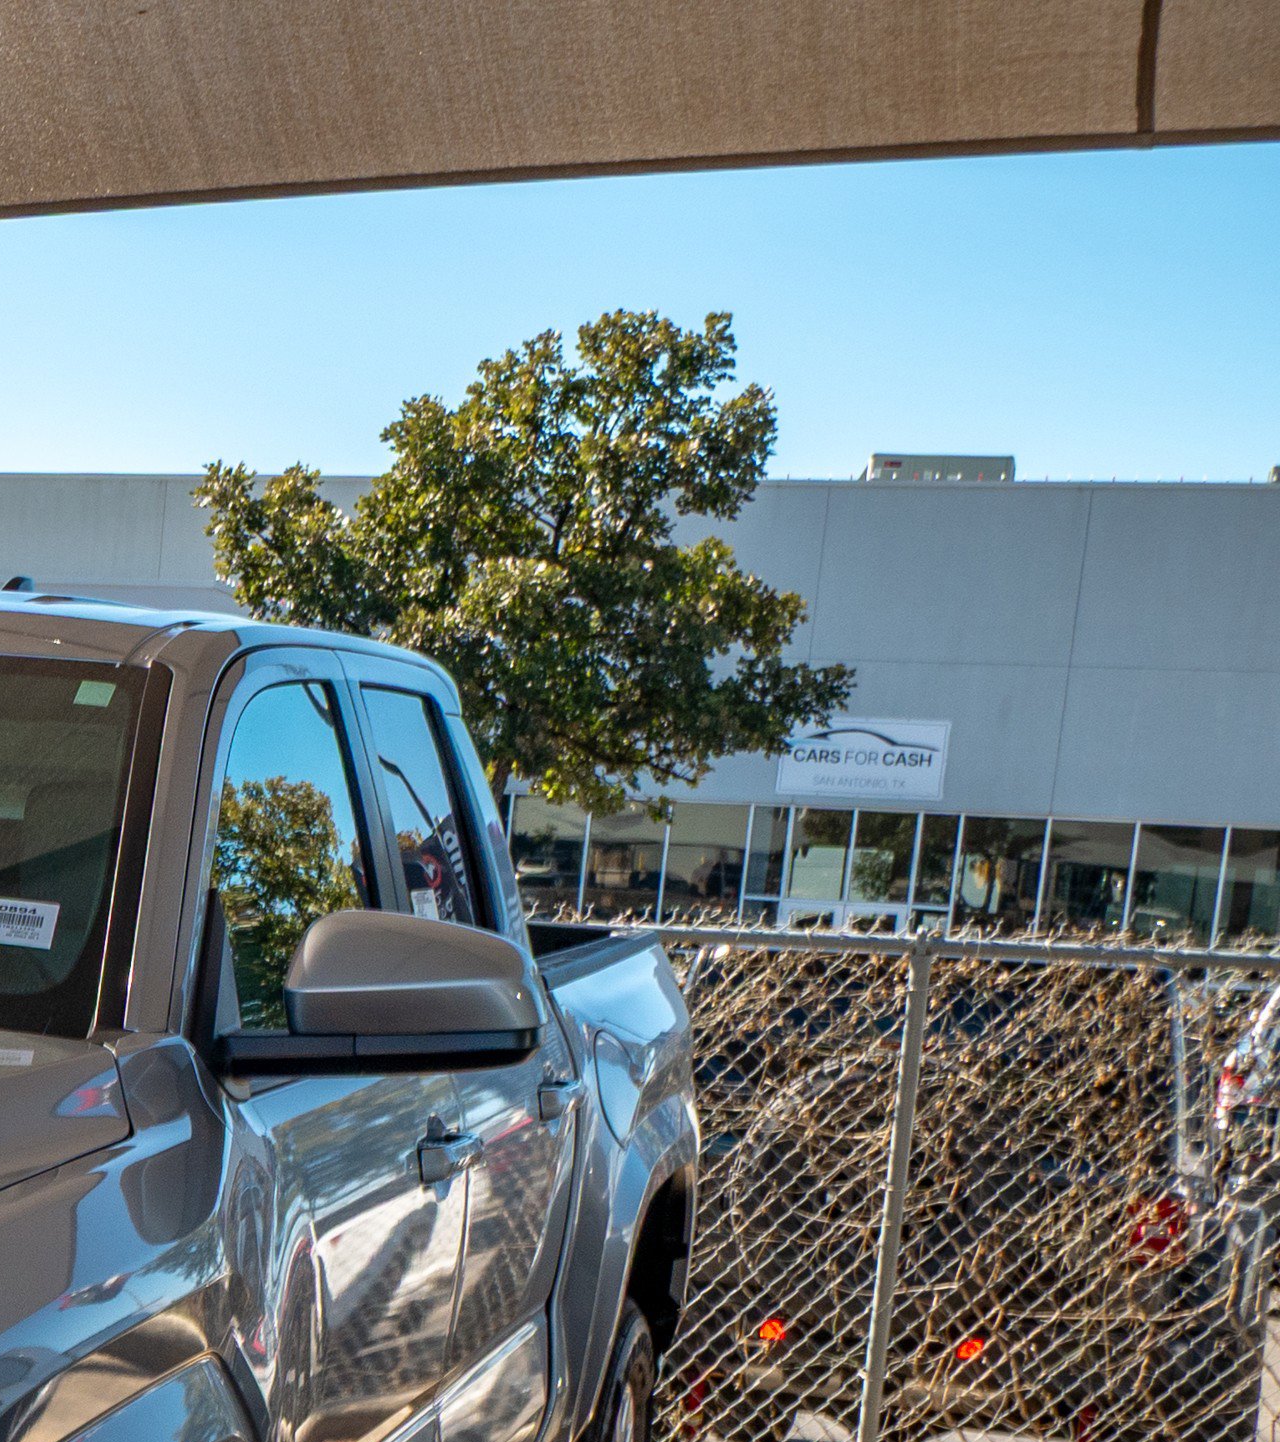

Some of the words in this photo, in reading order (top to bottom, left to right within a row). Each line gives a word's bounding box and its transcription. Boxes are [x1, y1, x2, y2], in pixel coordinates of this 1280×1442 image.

[793, 749, 840, 764] CARS
[844, 751, 879, 766] FOR
[882, 752, 932, 767] CASH
[813, 775, 836, 787] SAN
[891, 778, 906, 789] TX
